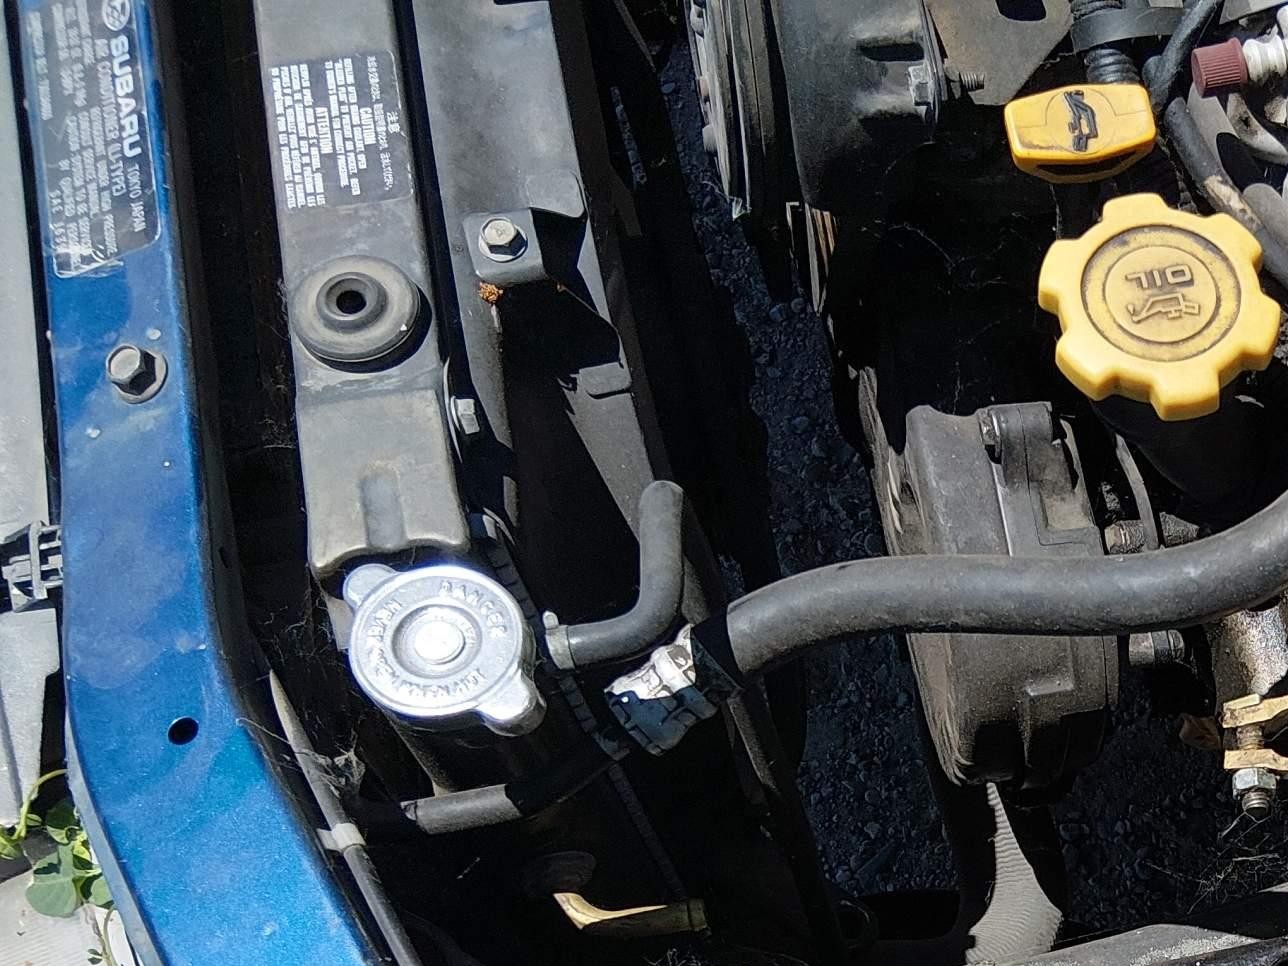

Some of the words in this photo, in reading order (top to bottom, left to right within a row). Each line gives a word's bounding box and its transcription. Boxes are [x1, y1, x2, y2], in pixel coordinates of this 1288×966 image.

[96, 60, 120, 140] CONDITIONER
[108, 34, 143, 157] SUBARU
[315, 106, 332, 154] ATTENTION
[359, 107, 376, 144] CAUTION
[386, 111, 400, 133] 注意
[125, 163, 142, 198] TOKYO
[130, 201, 146, 231] JAPAN
[1125, 264, 1193, 289] OIL
[439, 579, 508, 639] DANGER
